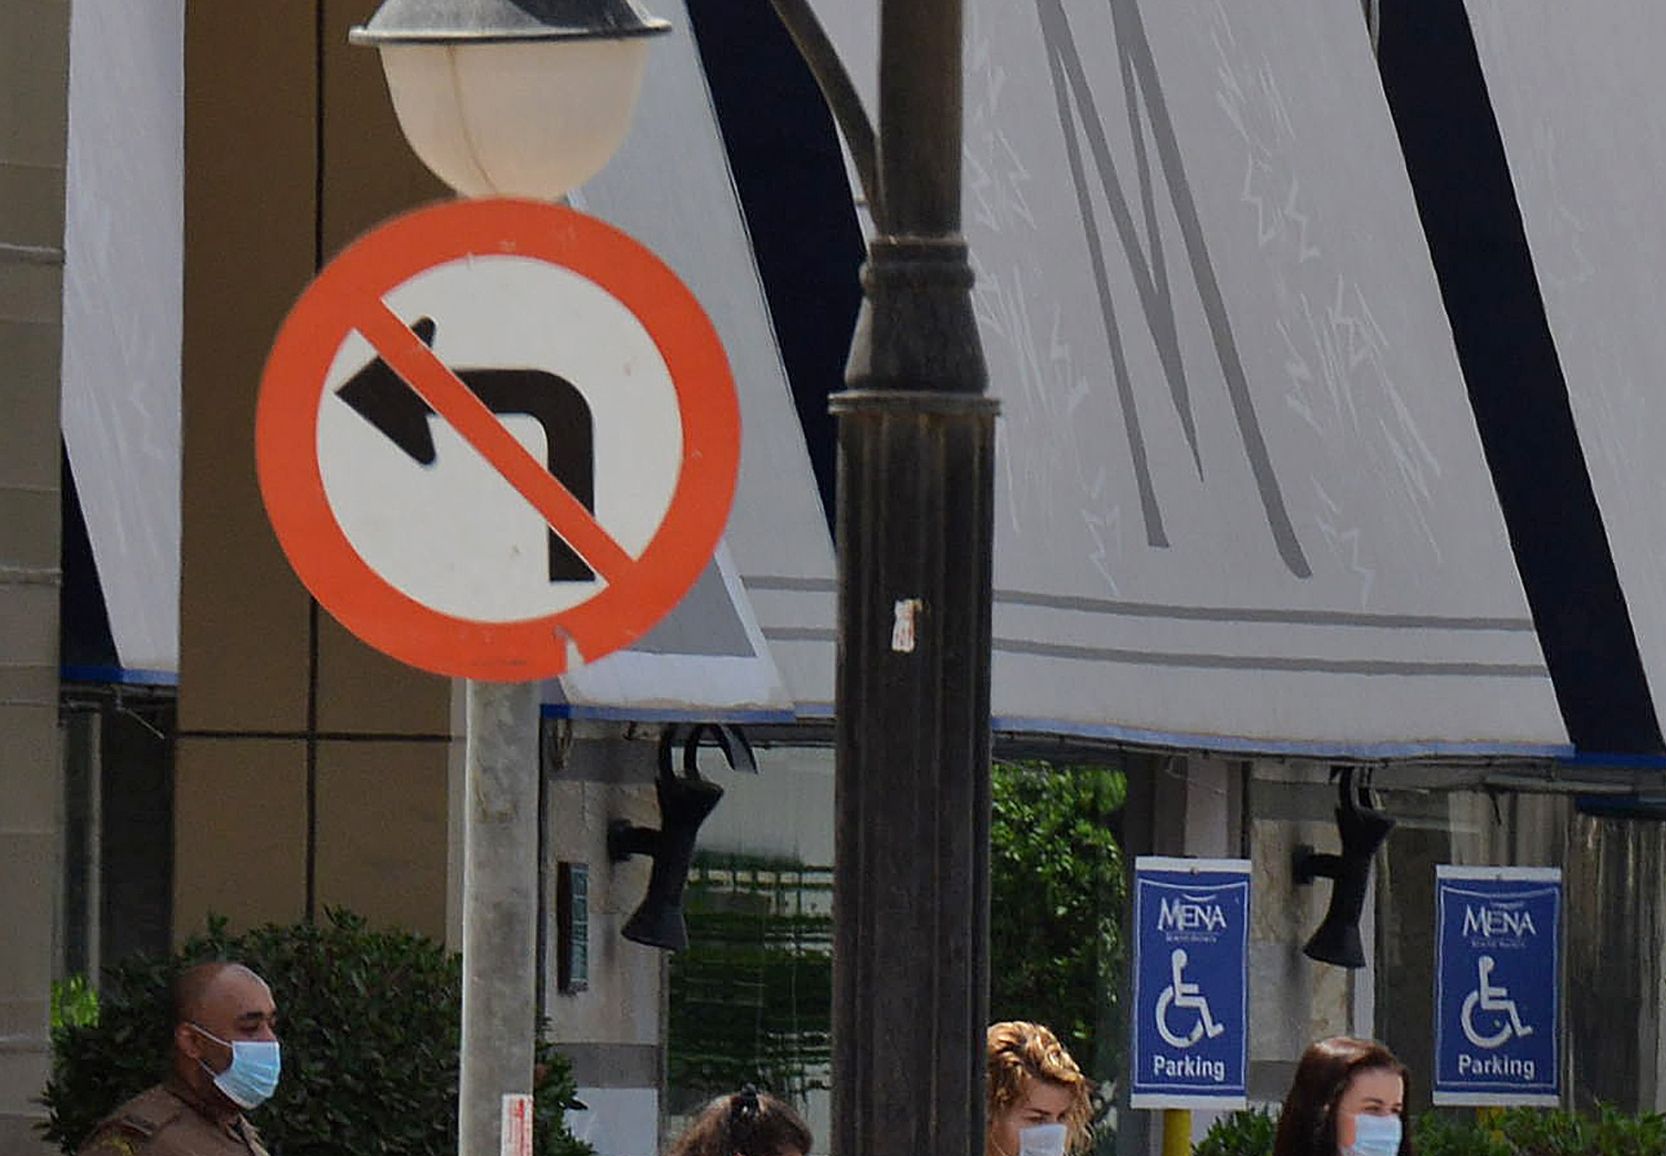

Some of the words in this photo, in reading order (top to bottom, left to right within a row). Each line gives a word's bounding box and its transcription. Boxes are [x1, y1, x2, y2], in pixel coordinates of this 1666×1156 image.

[1157, 896, 1227, 931] MENA
[1462, 903, 1537, 938] MENA
[1152, 1053, 1225, 1082] Parking
[1457, 1053, 1536, 1080] Parking
